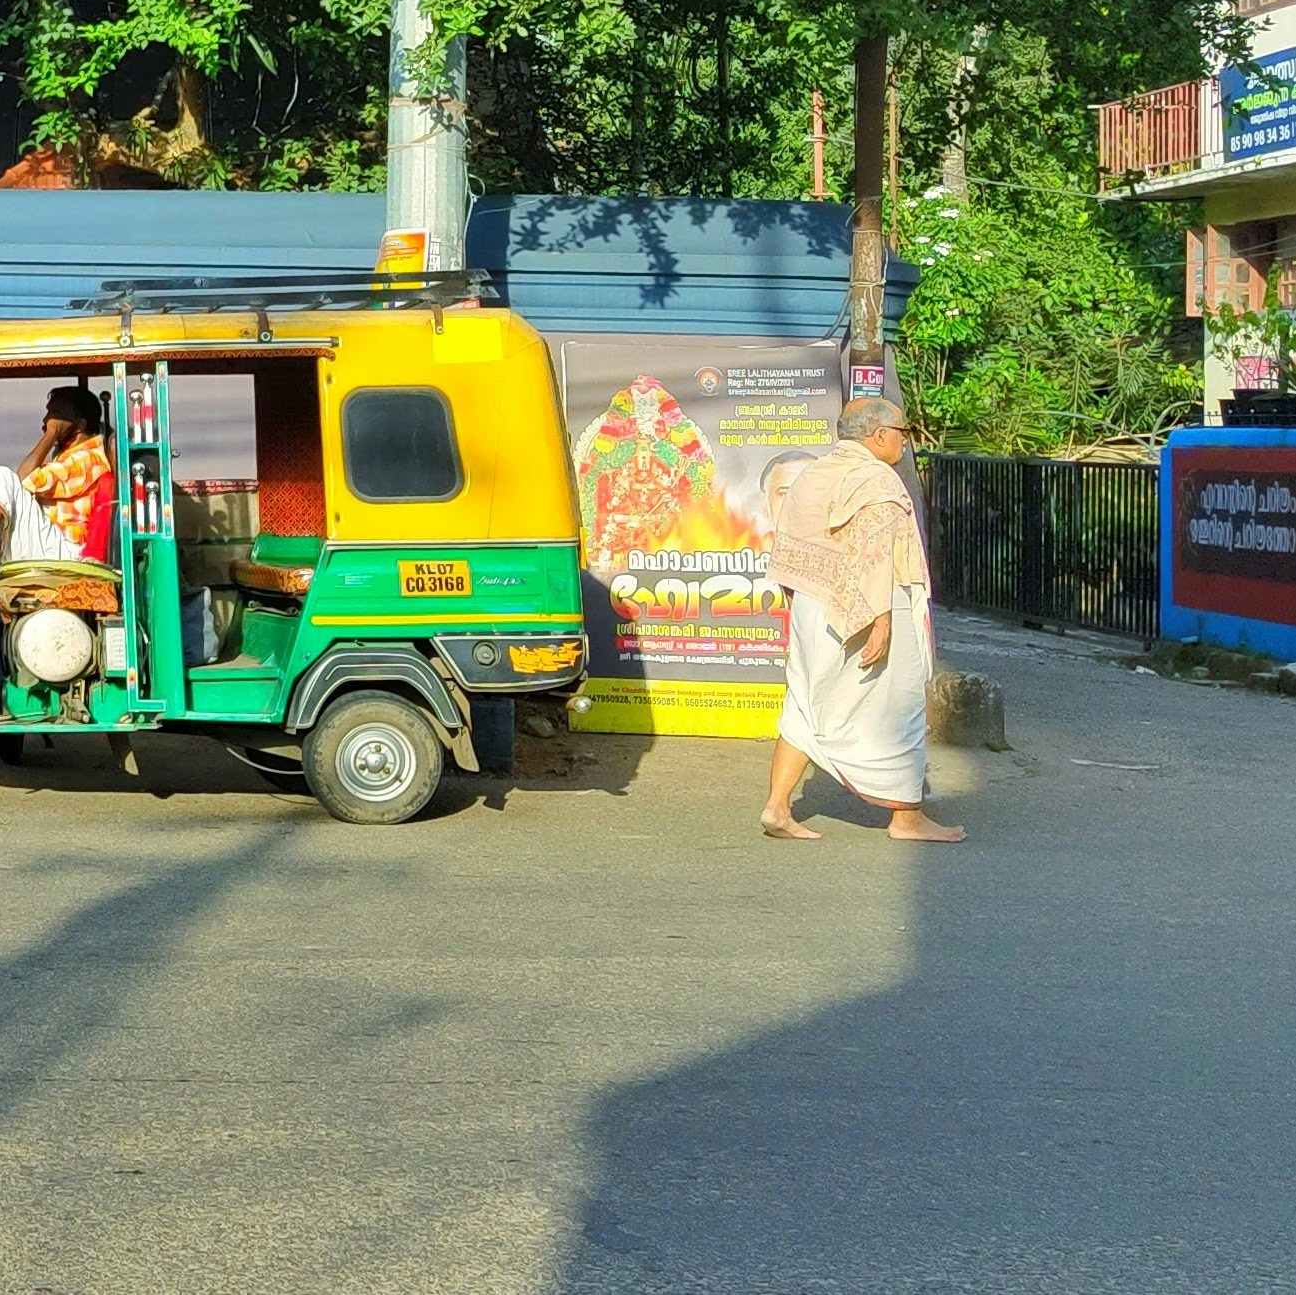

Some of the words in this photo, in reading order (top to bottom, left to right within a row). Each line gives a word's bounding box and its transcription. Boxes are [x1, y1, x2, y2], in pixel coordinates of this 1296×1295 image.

[1230, 136, 1241, 153] 85
[1242, 132, 1253, 150] 90
[1254, 129, 1265, 147] 98
[1267, 126, 1278, 144] 34
[1279, 123, 1290, 142] 36
[802, 368, 825, 377] TRUST
